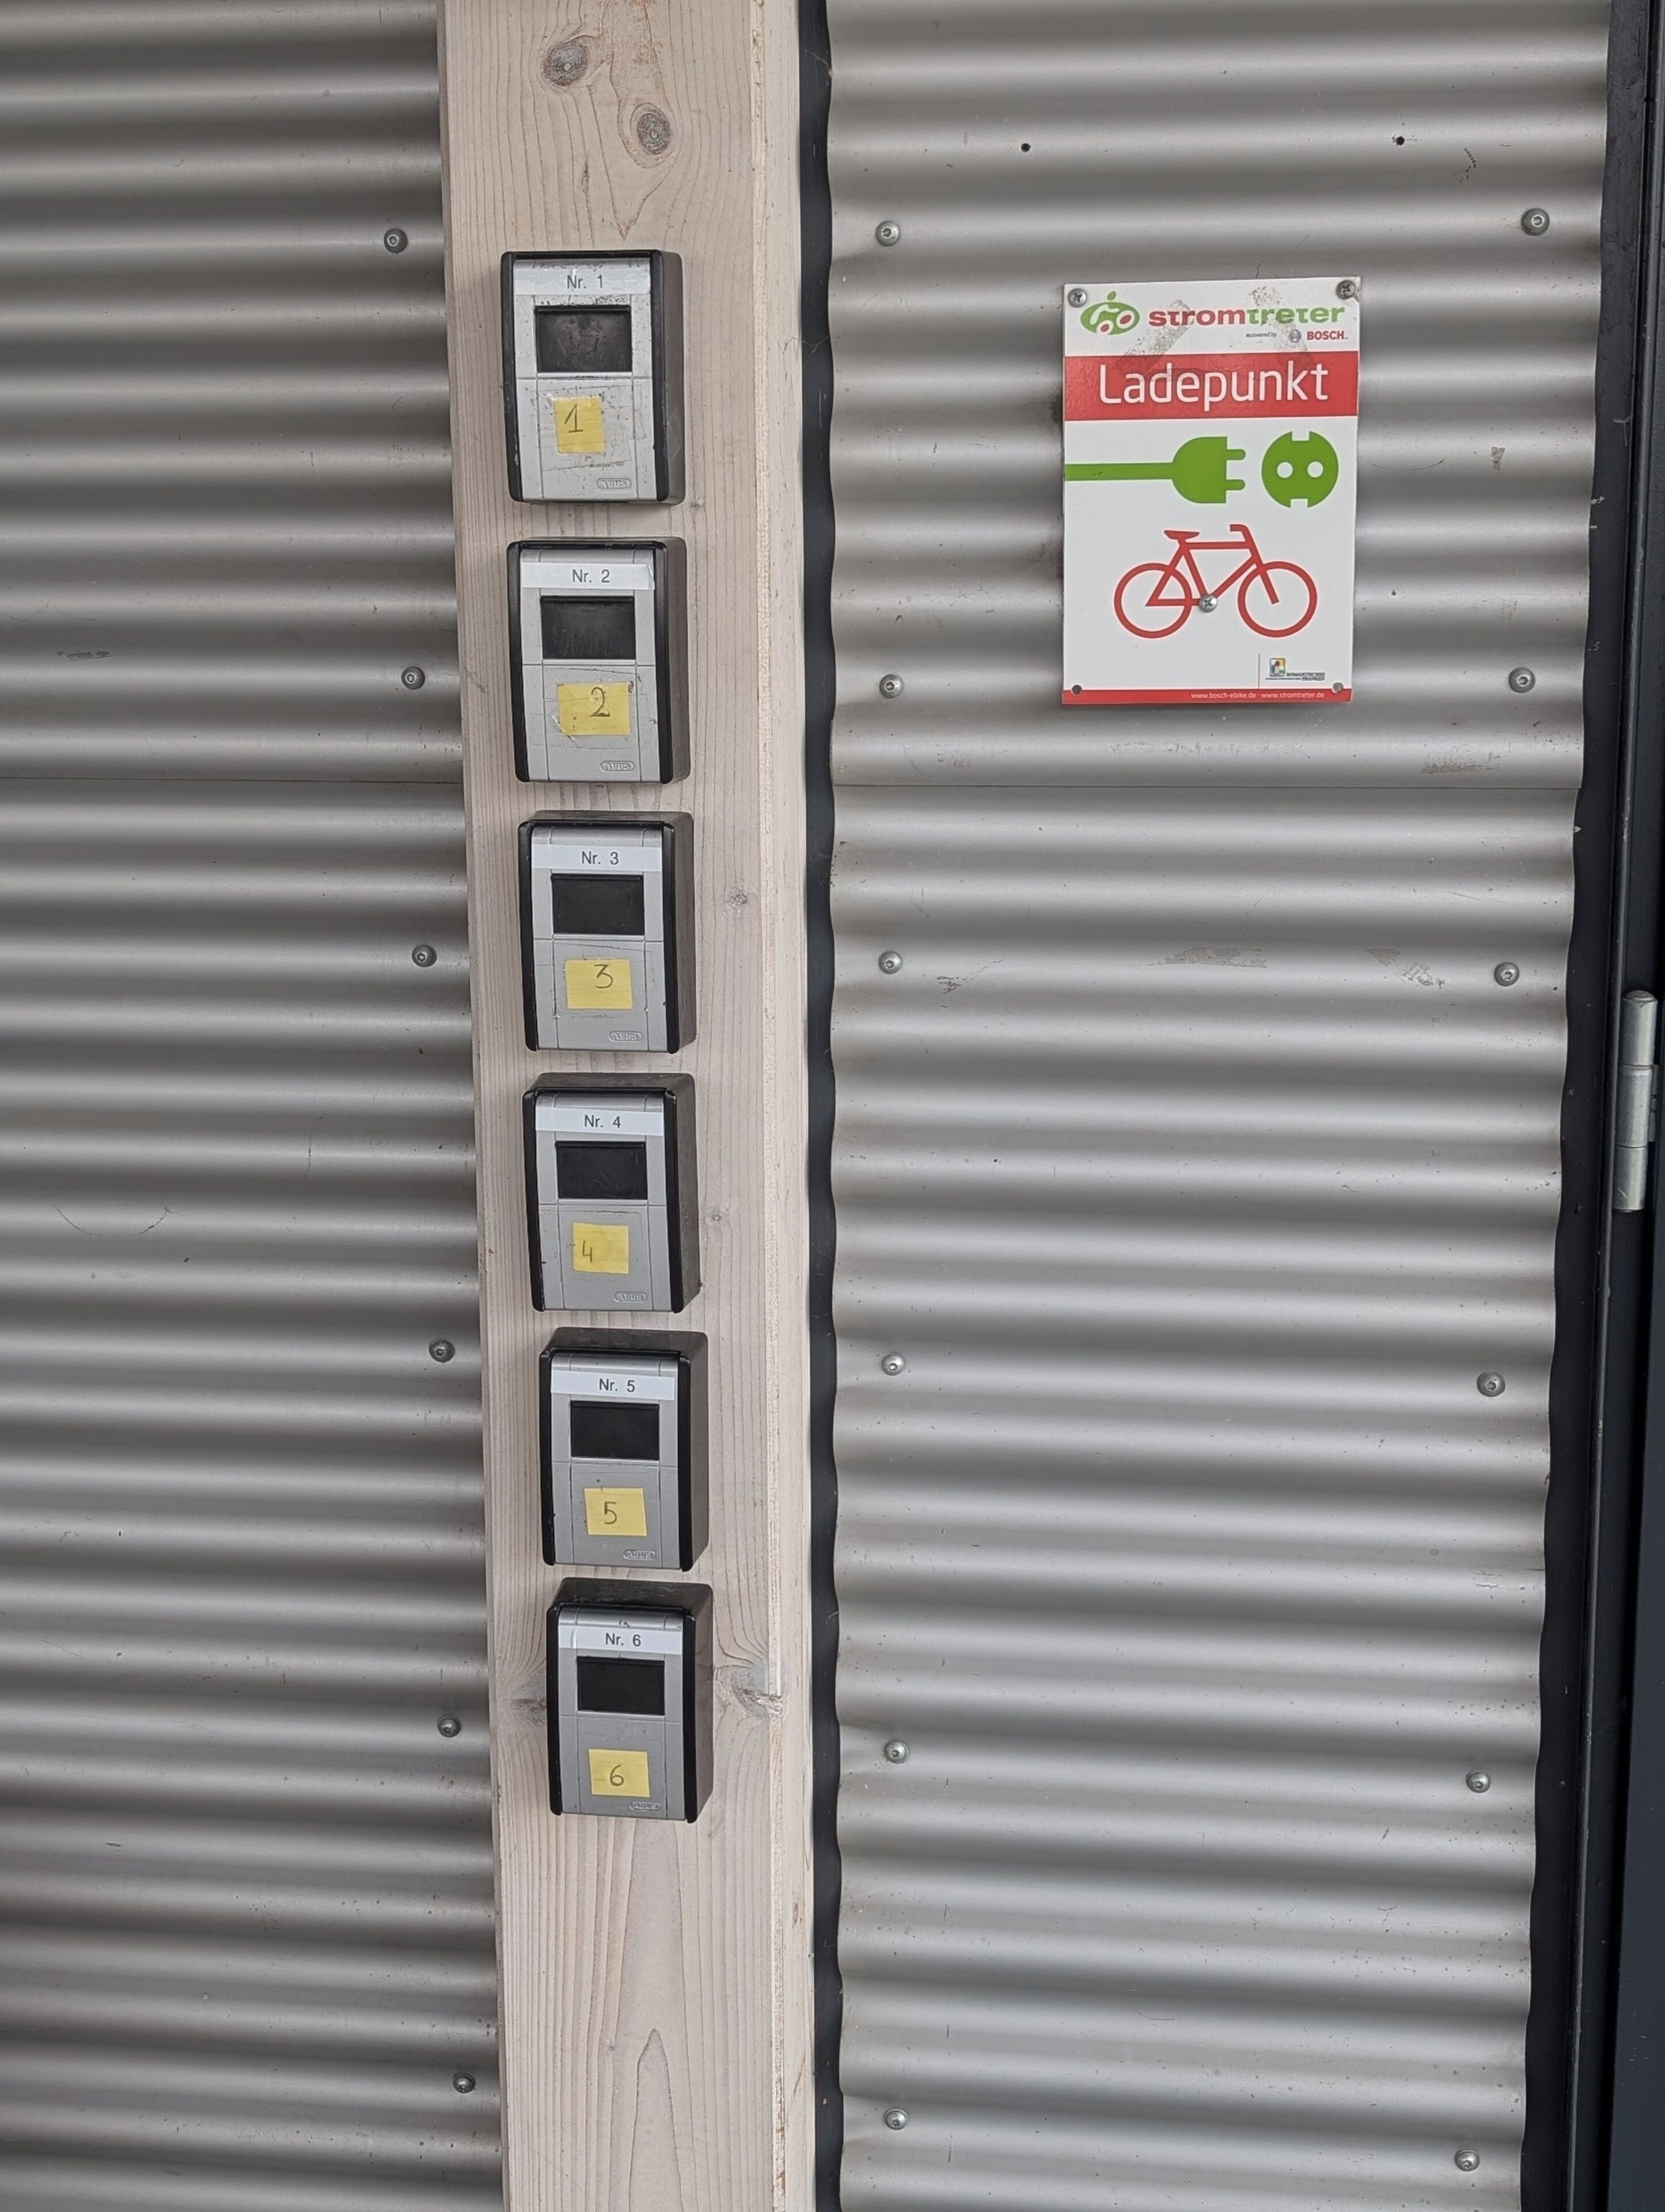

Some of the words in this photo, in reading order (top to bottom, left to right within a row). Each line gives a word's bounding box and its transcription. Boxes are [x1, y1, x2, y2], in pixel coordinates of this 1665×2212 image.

[567, 275, 586, 289] Nr.
[597, 276, 604, 289] 1
[1148, 306, 1345, 327] stromtreter
[1307, 331, 1344, 340] BOSCH
[1099, 360, 1329, 412] Ladepunkt
[564, 404, 583, 433] 1
[572, 569, 592, 583] Nr.
[601, 569, 610, 583] 2
[590, 687, 610, 717] 2
[581, 851, 601, 865] Nr.
[610, 851, 619, 865] 3
[594, 964, 613, 989] 3
[584, 1115, 604, 1128] Nr.
[612, 1115, 621, 1128] 4
[582, 1240, 593, 1263] 4
[599, 1378, 618, 1392] Nr.
[627, 1380, 636, 1393] 5
[603, 1501, 617, 1525] 5
[605, 1633, 624, 1646] Nr.
[632, 1634, 642, 1647] 6
[609, 1764, 624, 1786] 6
